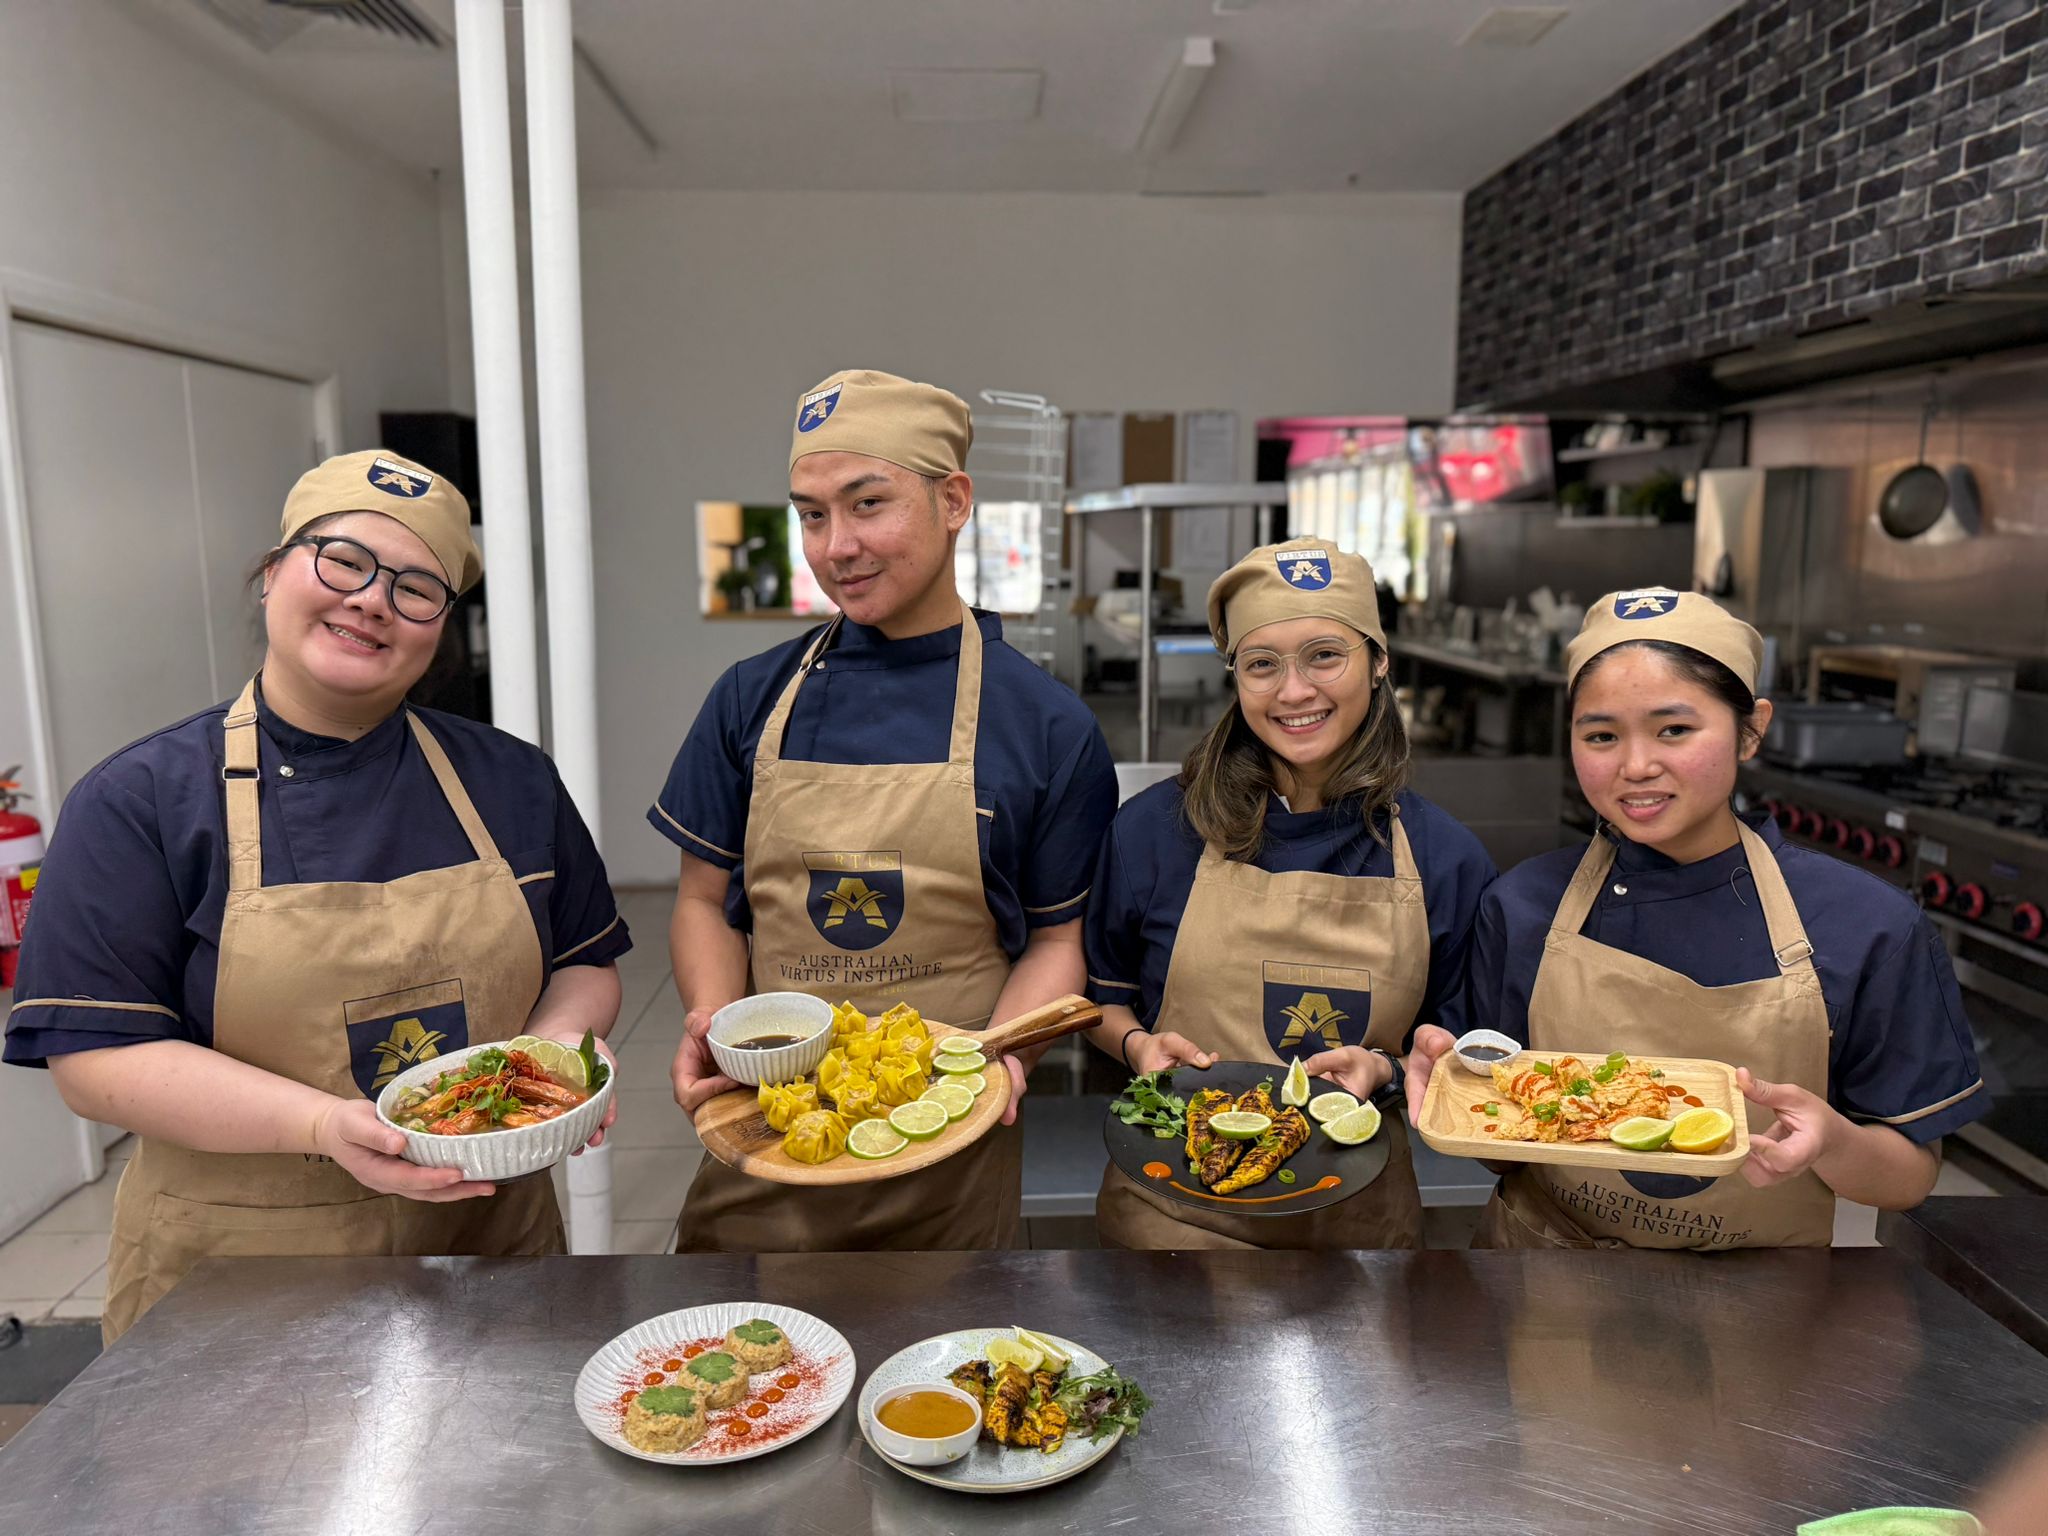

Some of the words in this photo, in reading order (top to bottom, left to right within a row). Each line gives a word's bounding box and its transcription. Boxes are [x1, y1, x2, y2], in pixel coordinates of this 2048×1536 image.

[780, 964, 836, 982] VIRTUS
[844, 962, 942, 983] INSTITUTE
[798, 953, 913, 968] AUSTRALIAN
[1550, 1182, 1622, 1223] VIRTUS
[1577, 1181, 1724, 1230] AUSTRALIAN
